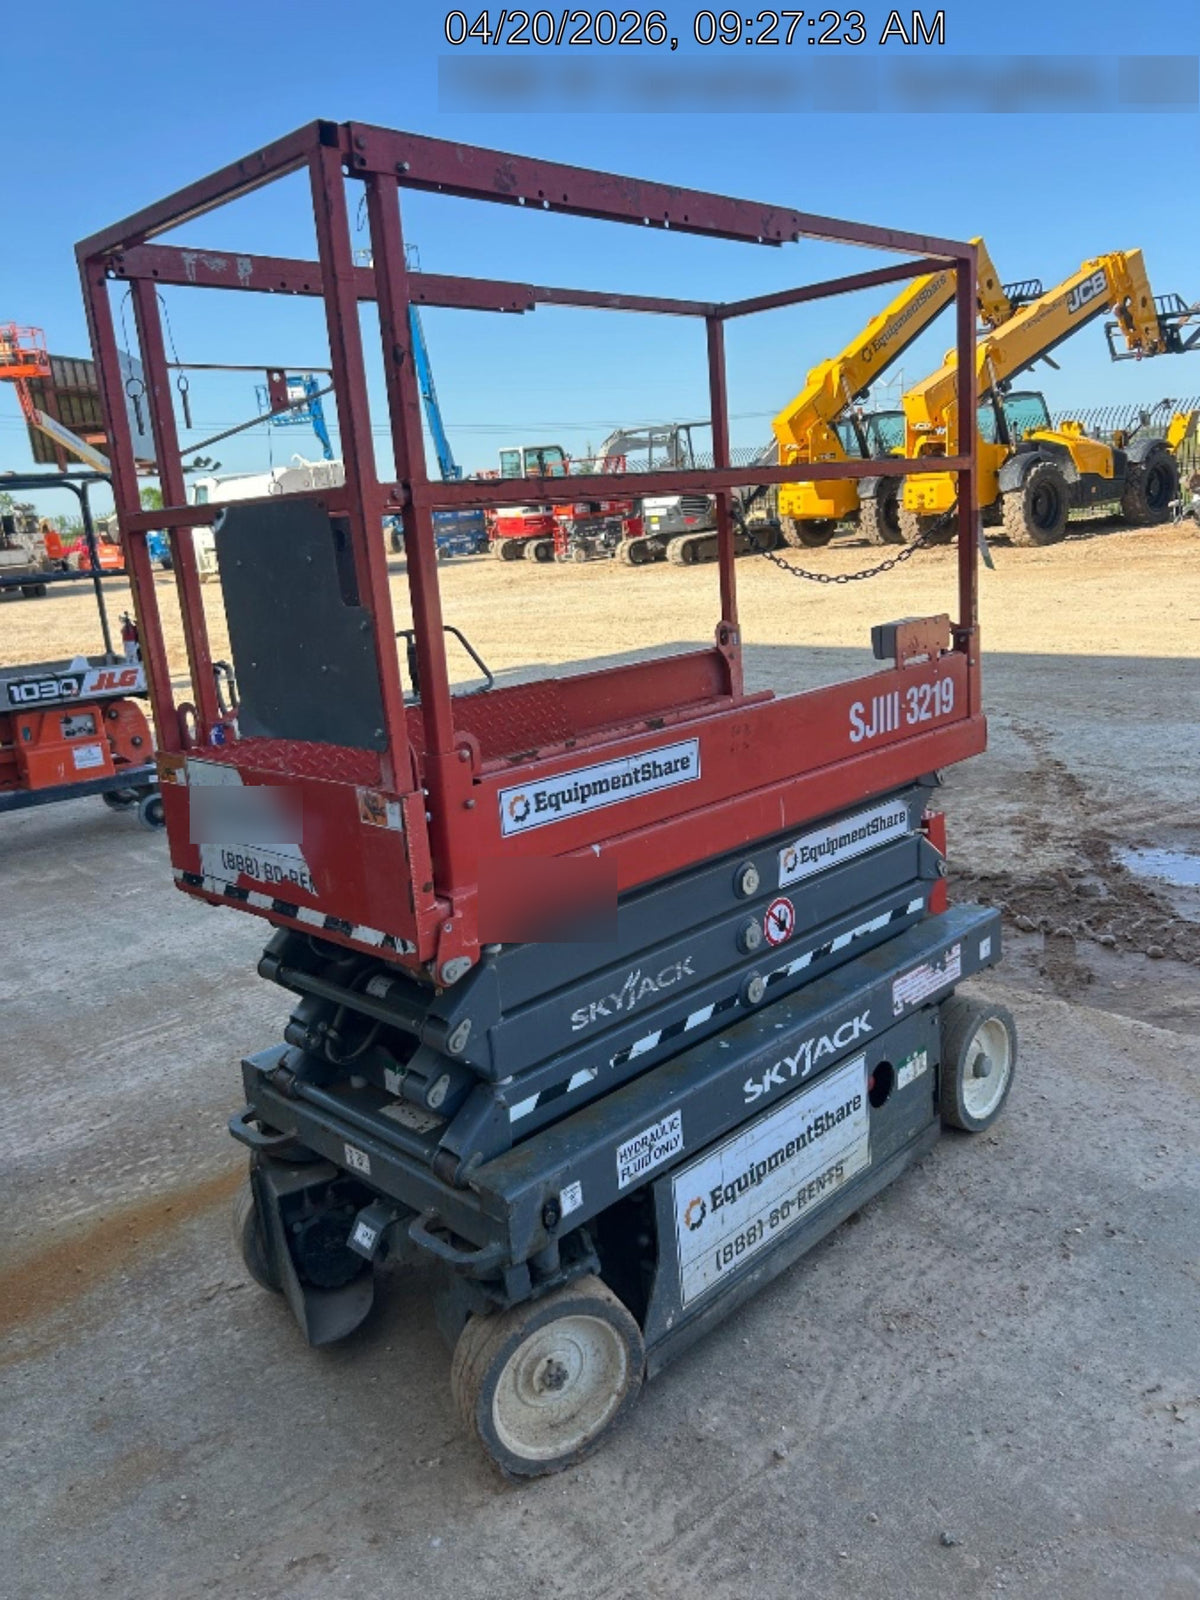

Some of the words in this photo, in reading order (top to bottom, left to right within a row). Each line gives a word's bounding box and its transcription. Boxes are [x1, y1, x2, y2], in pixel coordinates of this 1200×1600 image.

[1068, 271, 1107, 313] JCB
[90, 669, 138, 692] JLG
[849, 690, 900, 743] SJIII
[906, 676, 955, 725] 3219
[533, 754, 691, 813] EquipmentShare
[221, 849, 260, 879] (888)
[799, 811, 906, 865] EquipmentShare
[570, 955, 696, 1031] SKYJACK
[743, 1009, 873, 1104] SKYJACK
[619, 1116, 680, 1164] HYDRAULIC
[621, 1153, 652, 1182] FLUID
[653, 1133, 680, 1160] ONLY
[708, 1094, 862, 1213] EquipmentShare
[714, 1219, 764, 1271] (888)
[768, 1161, 845, 1230] 80-RENTS
